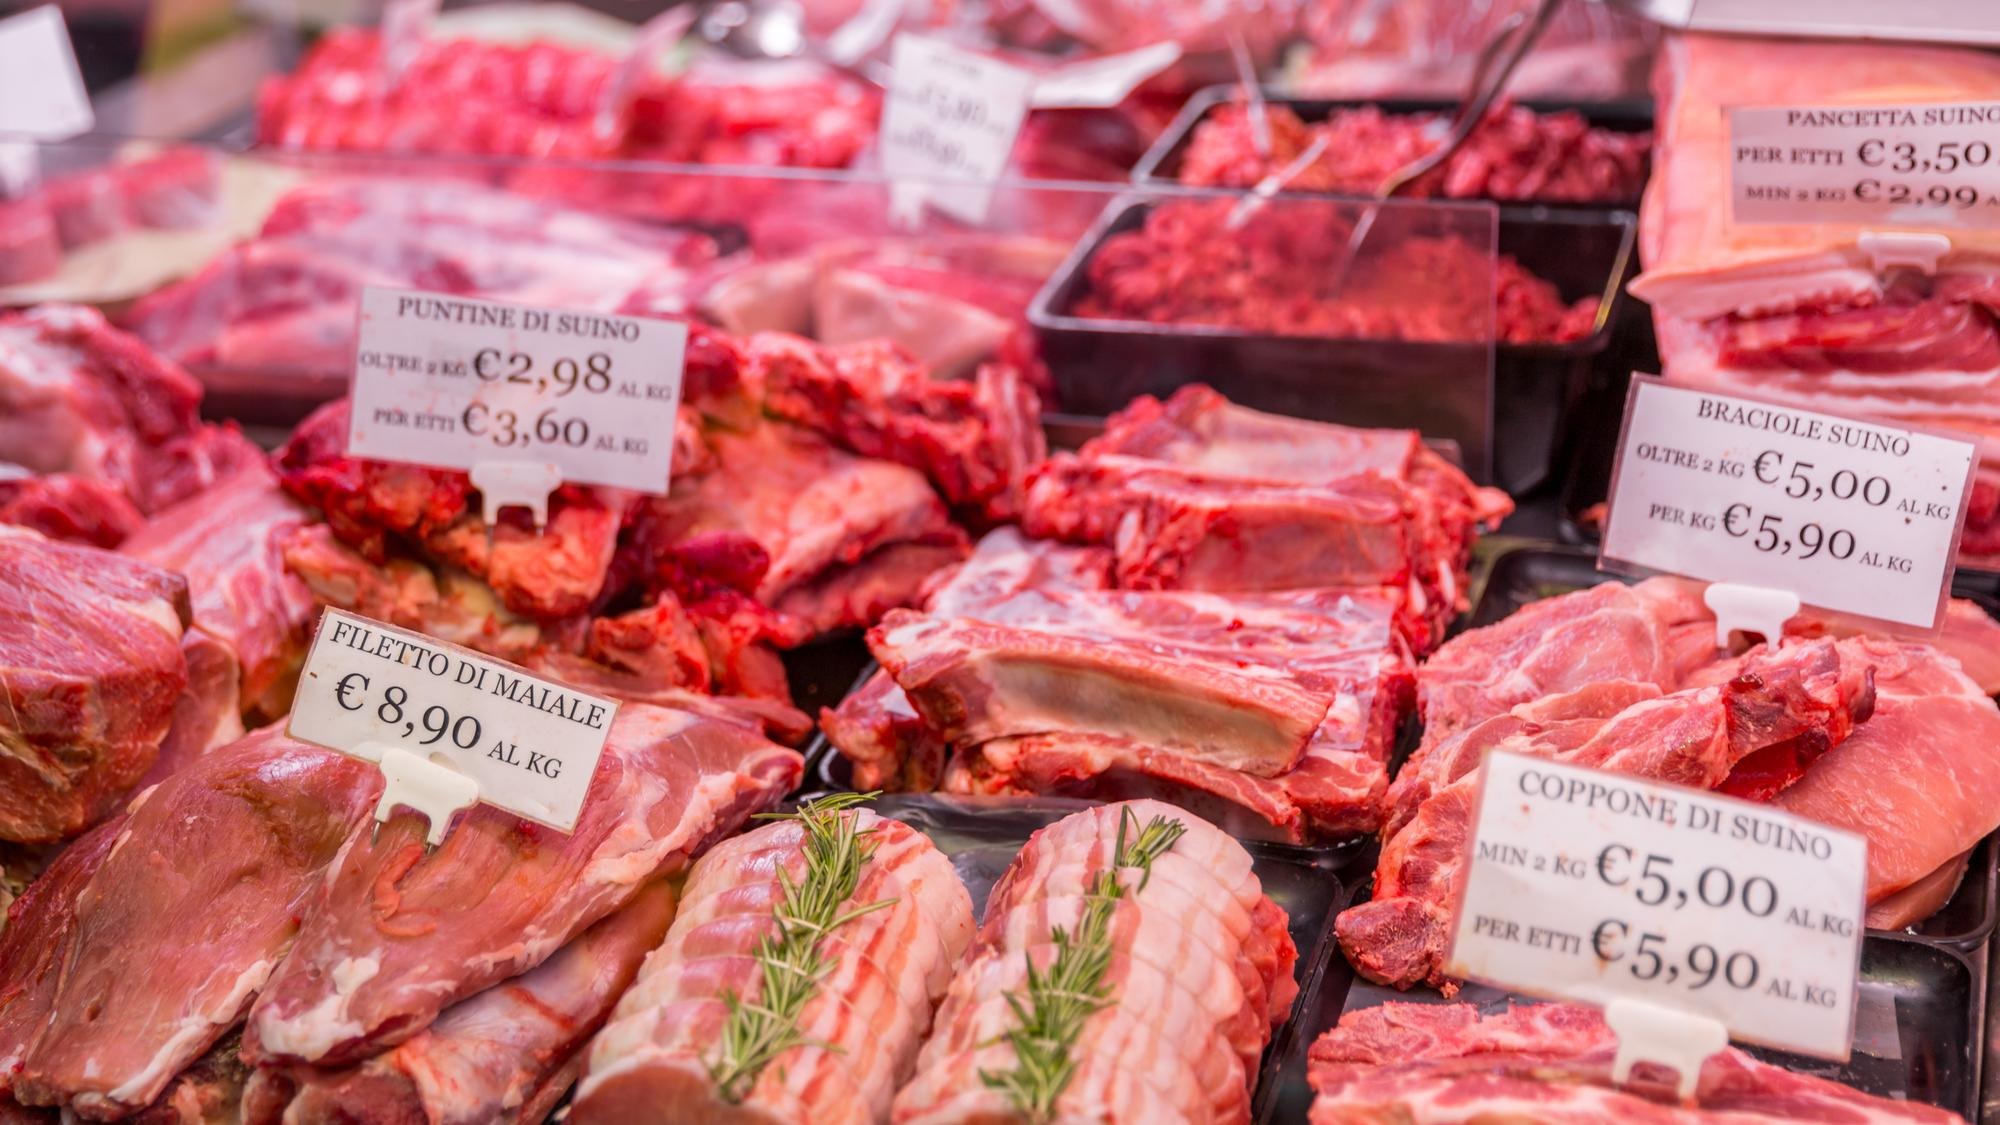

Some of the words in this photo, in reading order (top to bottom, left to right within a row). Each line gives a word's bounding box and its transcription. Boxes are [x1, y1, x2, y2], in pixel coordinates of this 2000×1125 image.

[1787, 109, 1916, 128] PANCETTA
[1737, 146, 1782, 164] PER
[1790, 148, 1844, 165] ETTI
[1858, 138, 1991, 174] €3,50
[1747, 186, 1790, 200] MIN
[1816, 188, 1846, 201] KG
[1853, 178, 1978, 209] €2,99
[398, 297, 515, 328] PUNTINE
[523, 310, 549, 332] DI
[556, 315, 640, 342] SUINO
[359, 350, 422, 373] OLTRE
[426, 362, 437, 374] 2
[441, 359, 467, 376] KG
[473, 348, 612, 397] €2,98
[617, 382, 641, 399] AL
[647, 385, 672, 401] KG
[373, 407, 408, 426] PER
[412, 411, 454, 432] ETTI
[462, 401, 588, 448] €3,60
[594, 436, 618, 452] AL
[624, 440, 648, 456] KG
[1697, 398, 1824, 440] BRACIOLE
[1828, 423, 1910, 457] SUINO
[1636, 442, 1699, 470] OLTRE
[1703, 458, 1713, 472] 2
[1718, 460, 1745, 479] KG
[1752, 450, 1890, 507] €5,00
[1896, 498, 1921, 515] AL
[1924, 503, 1950, 520] KG
[1649, 503, 1686, 525] PER
[1689, 510, 1716, 531] KG
[1722, 502, 1856, 560] €5,90
[1860, 550, 1883, 568] AL
[1886, 556, 1912, 574] KG
[330, 620, 449, 676] FILETTO
[454, 661, 488, 690] DI
[492, 673, 606, 730] MAIALE
[487, 740, 520, 766] AL
[526, 750, 562, 780] KG
[1519, 769, 1678, 826] COPPONE
[1686, 805, 1722, 834] DI
[1731, 815, 1832, 861] SUINO
[1476, 841, 1528, 868] MIN
[1534, 857, 1546, 871] 2
[1555, 856, 1587, 879] KG
[1596, 842, 1778, 920] €5,00
[1785, 907, 1816, 929] AL
[1822, 914, 1853, 938] KG
[1473, 914, 1520, 943] PER
[1526, 927, 1582, 956] ETTI
[1591, 918, 1760, 992] €5,90
[1765, 979, 1797, 1000] AL
[1803, 985, 1837, 1009] KG
